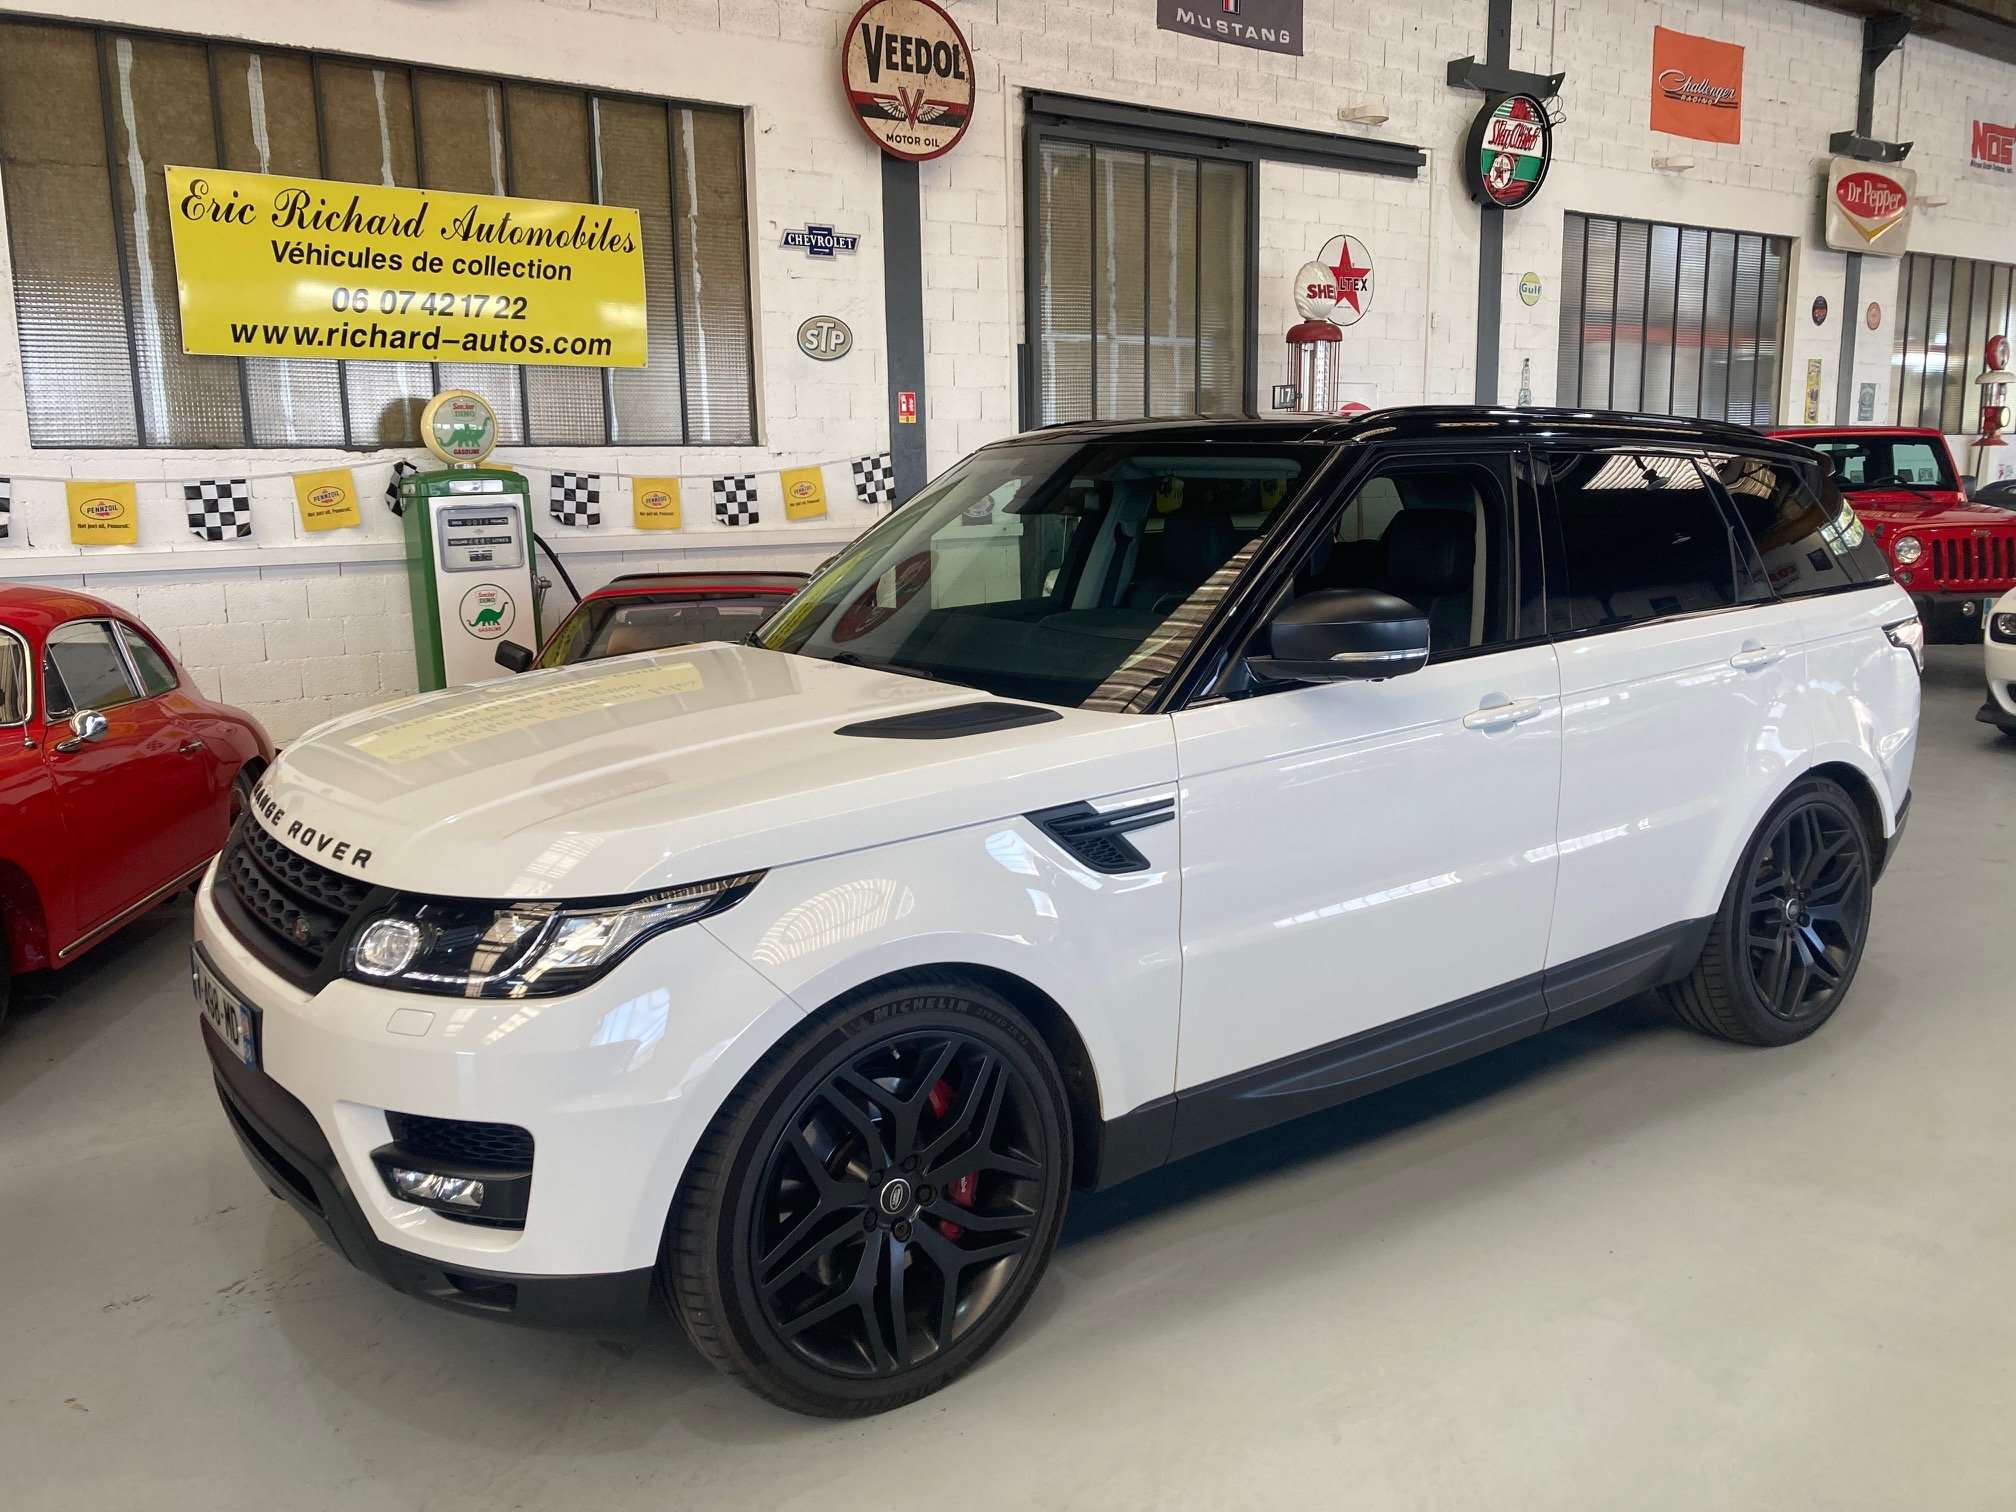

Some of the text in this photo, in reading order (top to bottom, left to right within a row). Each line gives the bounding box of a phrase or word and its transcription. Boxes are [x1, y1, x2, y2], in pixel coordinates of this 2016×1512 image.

[1176, 7, 1290, 43] MUSTANG
[861, 23, 966, 83] VEEDOL
[1658, 68, 1736, 104] Challenger
[886, 133, 940, 148] MOTOR OIL
[1847, 180, 1902, 215] Dr Pepper
[181, 179, 637, 254] Eric Richard Automobiles
[787, 233, 854, 249] CHEVROLET
[271, 240, 572, 281] Véhicules de collection
[332, 287, 369, 313] 06
[1521, 283, 1542, 295] Gulf
[230, 321, 612, 356] www.richard-autos.com
[805, 321, 845, 354] STP
[86, 504, 118, 514] PENNZOIL
[253, 780, 373, 869] RANGE ROVER
